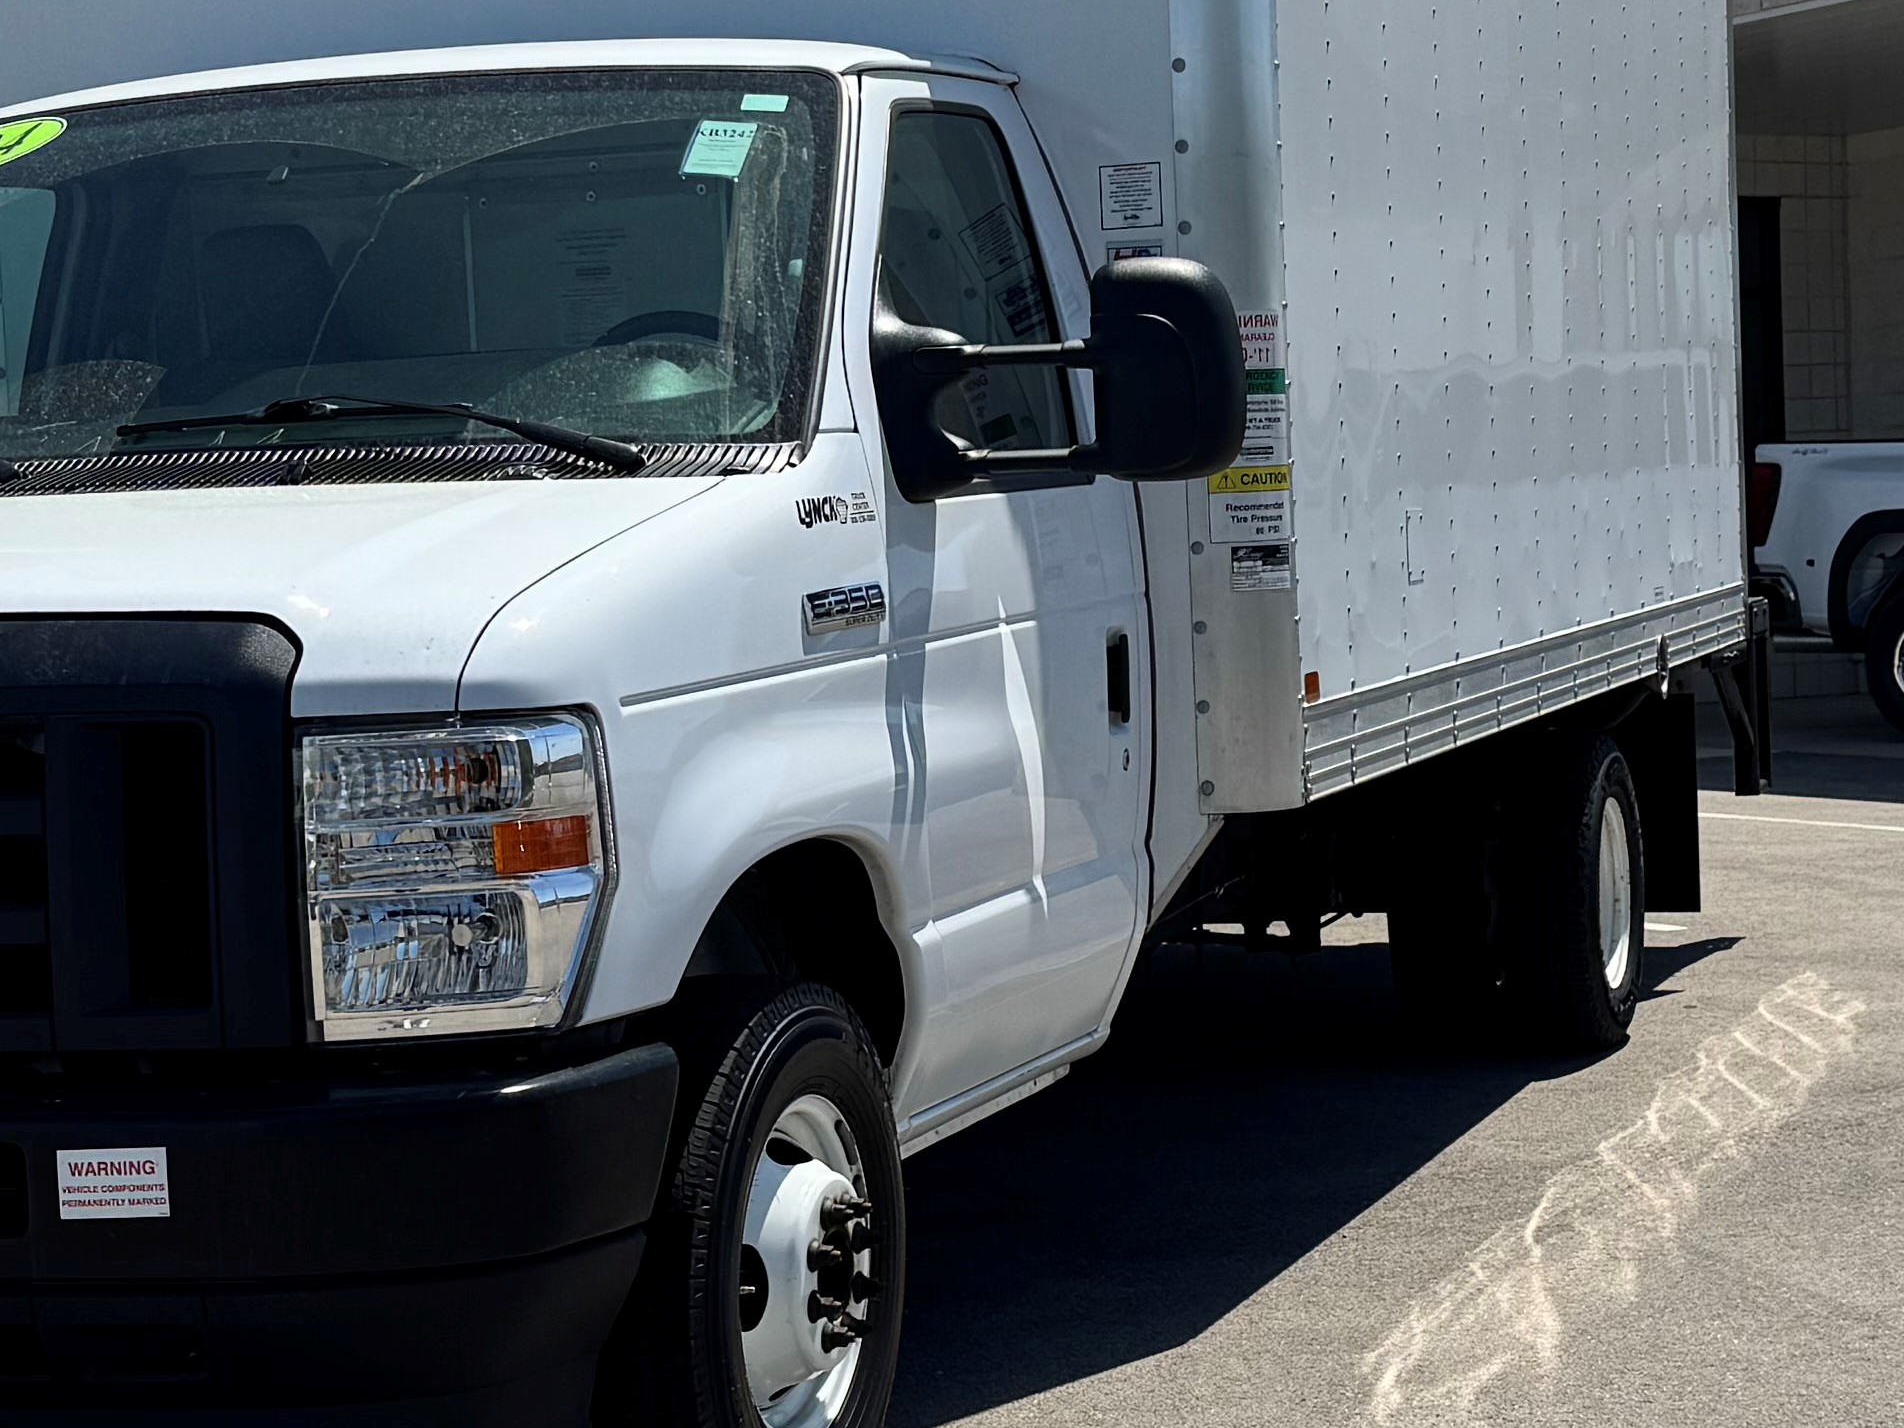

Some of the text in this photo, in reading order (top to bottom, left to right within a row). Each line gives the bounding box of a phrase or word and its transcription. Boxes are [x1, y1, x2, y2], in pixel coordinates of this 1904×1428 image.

[795, 495, 838, 529] LYNCH
[67, 1160, 156, 1177] WARNING
[61, 1183, 165, 1195] VEHICLE COMPONENTS
[61, 1197, 167, 1208] PERMANENTLY MARKED
